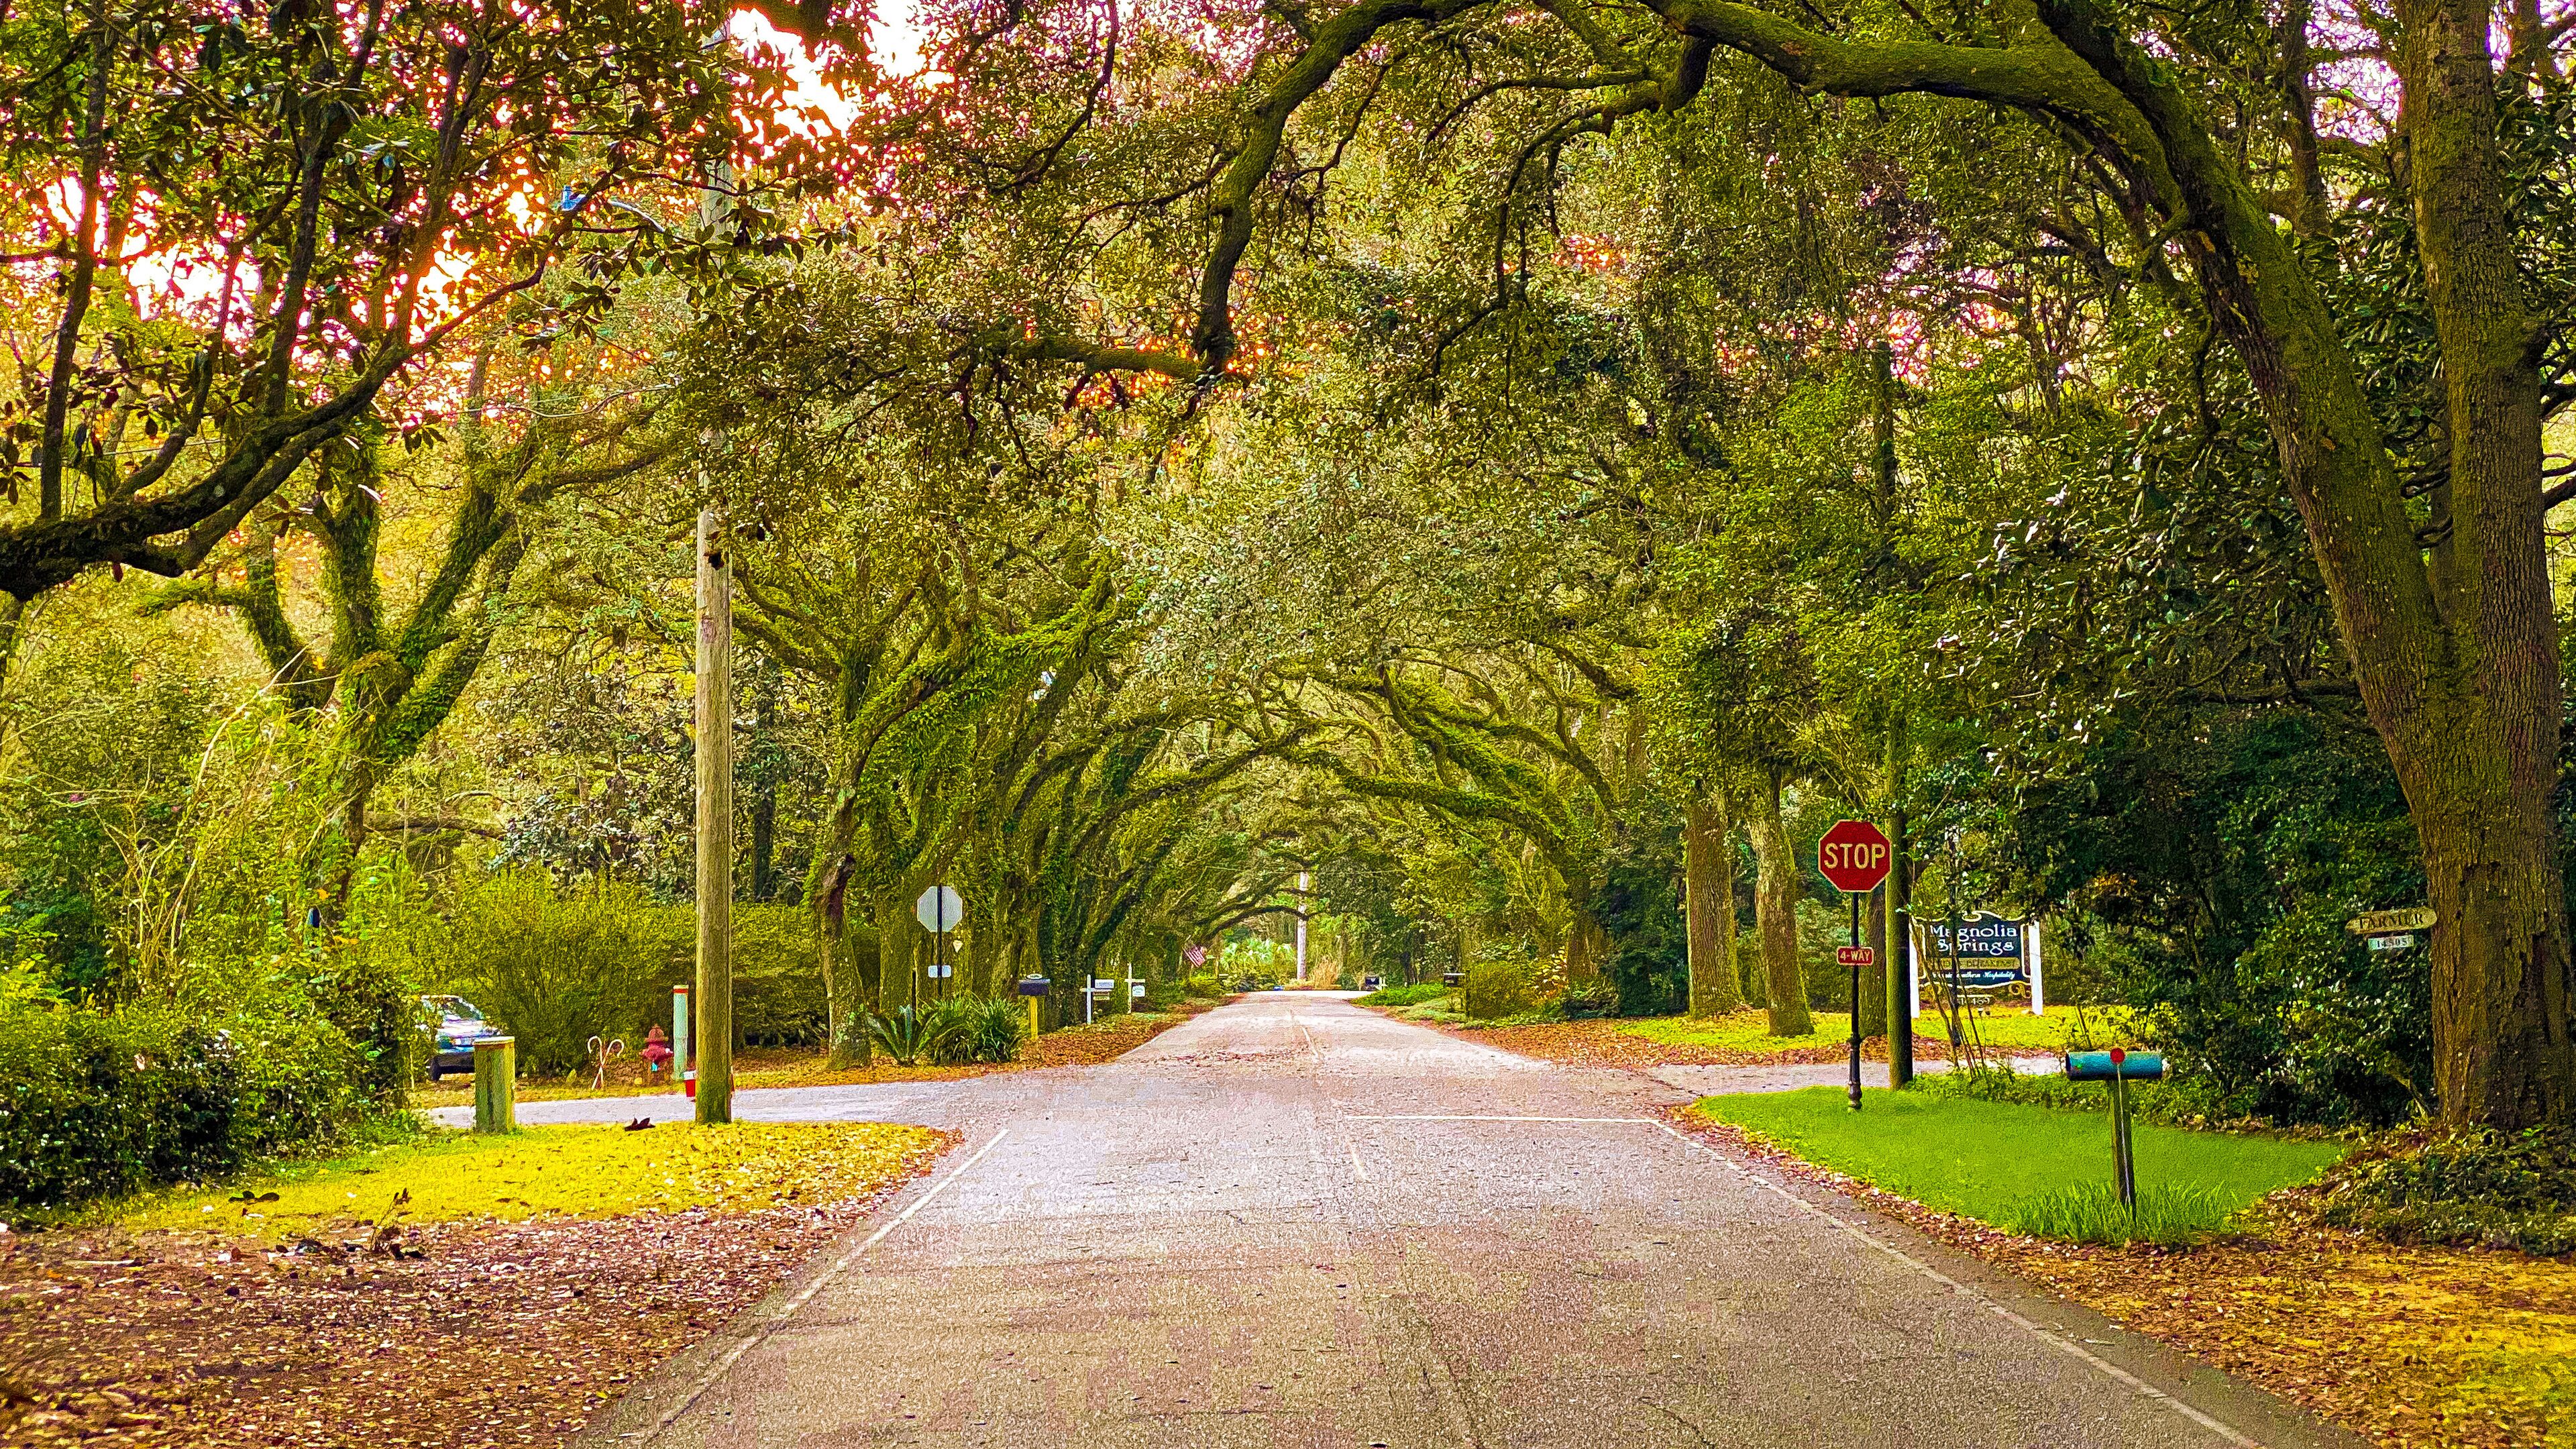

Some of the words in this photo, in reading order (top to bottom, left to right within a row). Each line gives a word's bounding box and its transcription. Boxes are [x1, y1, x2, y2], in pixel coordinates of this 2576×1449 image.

[1824, 843, 1886, 869] STOP
[2359, 914, 2424, 929] FARMER
[1930, 924, 2018, 942] Magnolia
[1938, 939, 2014, 955] Springs
[1840, 951, 1870, 962] 4-WAY
